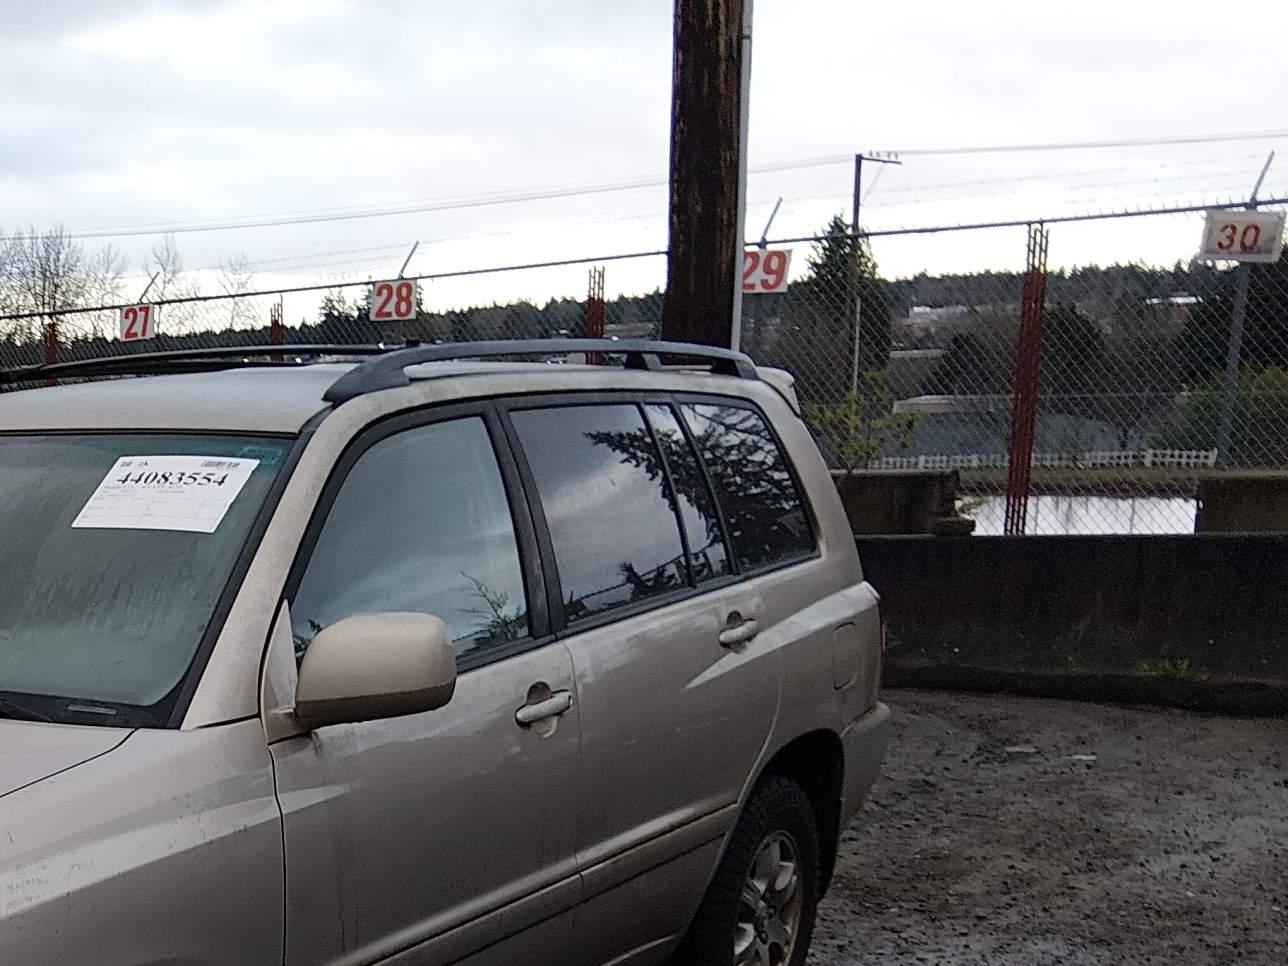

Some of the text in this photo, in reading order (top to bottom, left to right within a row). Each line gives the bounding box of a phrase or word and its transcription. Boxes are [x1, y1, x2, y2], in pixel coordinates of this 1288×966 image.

[1216, 223, 1260, 252] 30
[743, 250, 787, 290] 29
[374, 281, 413, 318] 28
[123, 305, 150, 339] 27
[116, 471, 230, 487] 44083554
